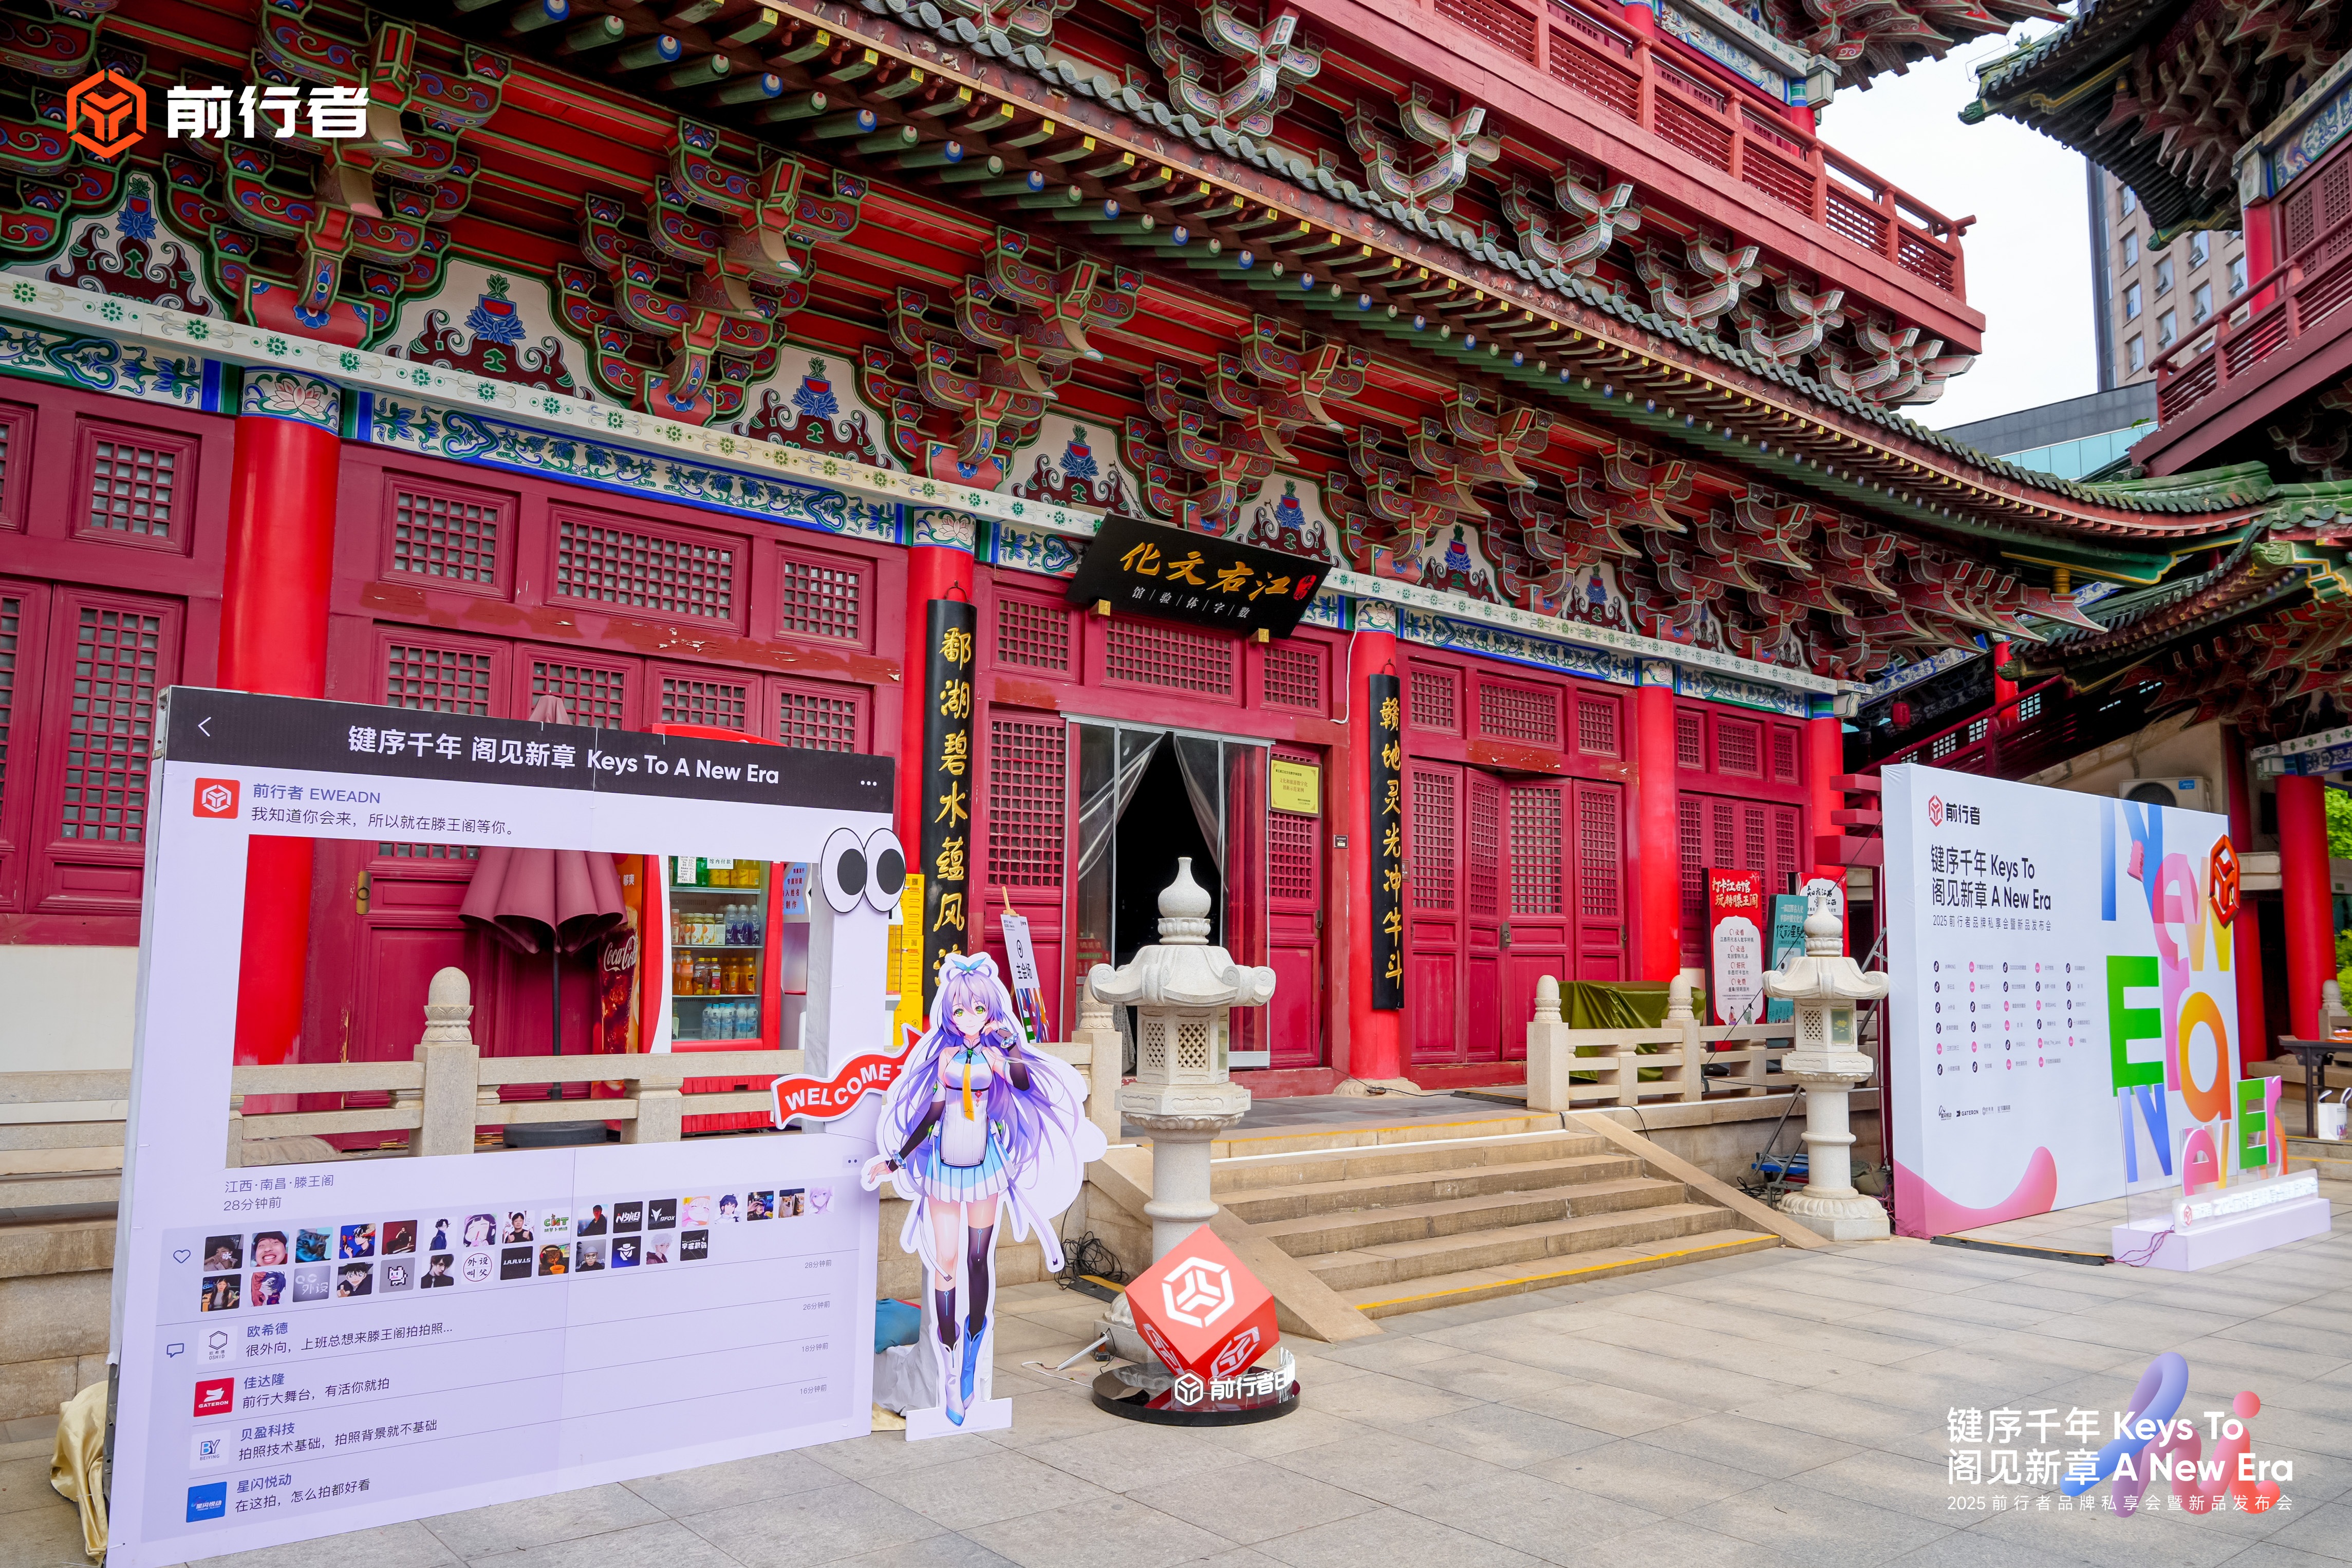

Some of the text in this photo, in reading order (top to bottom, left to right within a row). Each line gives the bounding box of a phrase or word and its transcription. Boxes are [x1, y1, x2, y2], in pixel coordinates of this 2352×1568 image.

[348, 725, 779, 784] 键序千年 阁见新章 Keys To A New Era
[253, 783, 380, 804] 前行者 EWEADN
[1946, 802, 1981, 826] 前行者
[1931, 844, 2035, 882] 键序千年 Keys To
[1712, 877, 1751, 893] 打卡江右馆
[1715, 893, 1758, 909] 玩转滕王阁
[1932, 877, 2051, 911] 阁见新章 A New Era
[1933, 914, 2051, 932] 2025 前行者品牌私享会暨新品发布会
[1016, 962, 1033, 979] 主会场
[785, 1064, 891, 1111] WELCOME
[223, 1197, 282, 1211] 28分钟前
[468, 1257, 489, 1266] 外设
[805, 1259, 832, 1268] 28分钟前
[467, 1268, 488, 1278] 叫父
[302, 1282, 329, 1295] 外设
[803, 1301, 830, 1311] 26分钟前
[248, 1322, 288, 1338] 欧希德
[801, 1342, 829, 1352] 18分钟前
[244, 1373, 285, 1389] 佳达隆
[800, 1384, 827, 1395] 16分钟前
[1210, 1373, 1274, 1402] 前行者
[242, 1378, 389, 1409] 前行大舞台，有活你就拍
[239, 1419, 438, 1461] 拍照技术基础，拍照背景就不基础
[241, 1422, 295, 1442] 贝盈科技
[200, 1439, 220, 1456] BY
[237, 1473, 291, 1493] 星闪悦动
[235, 1478, 370, 1513] 在这拍，怎么拍都好看
[196, 1500, 222, 1509] 星闪悦动
